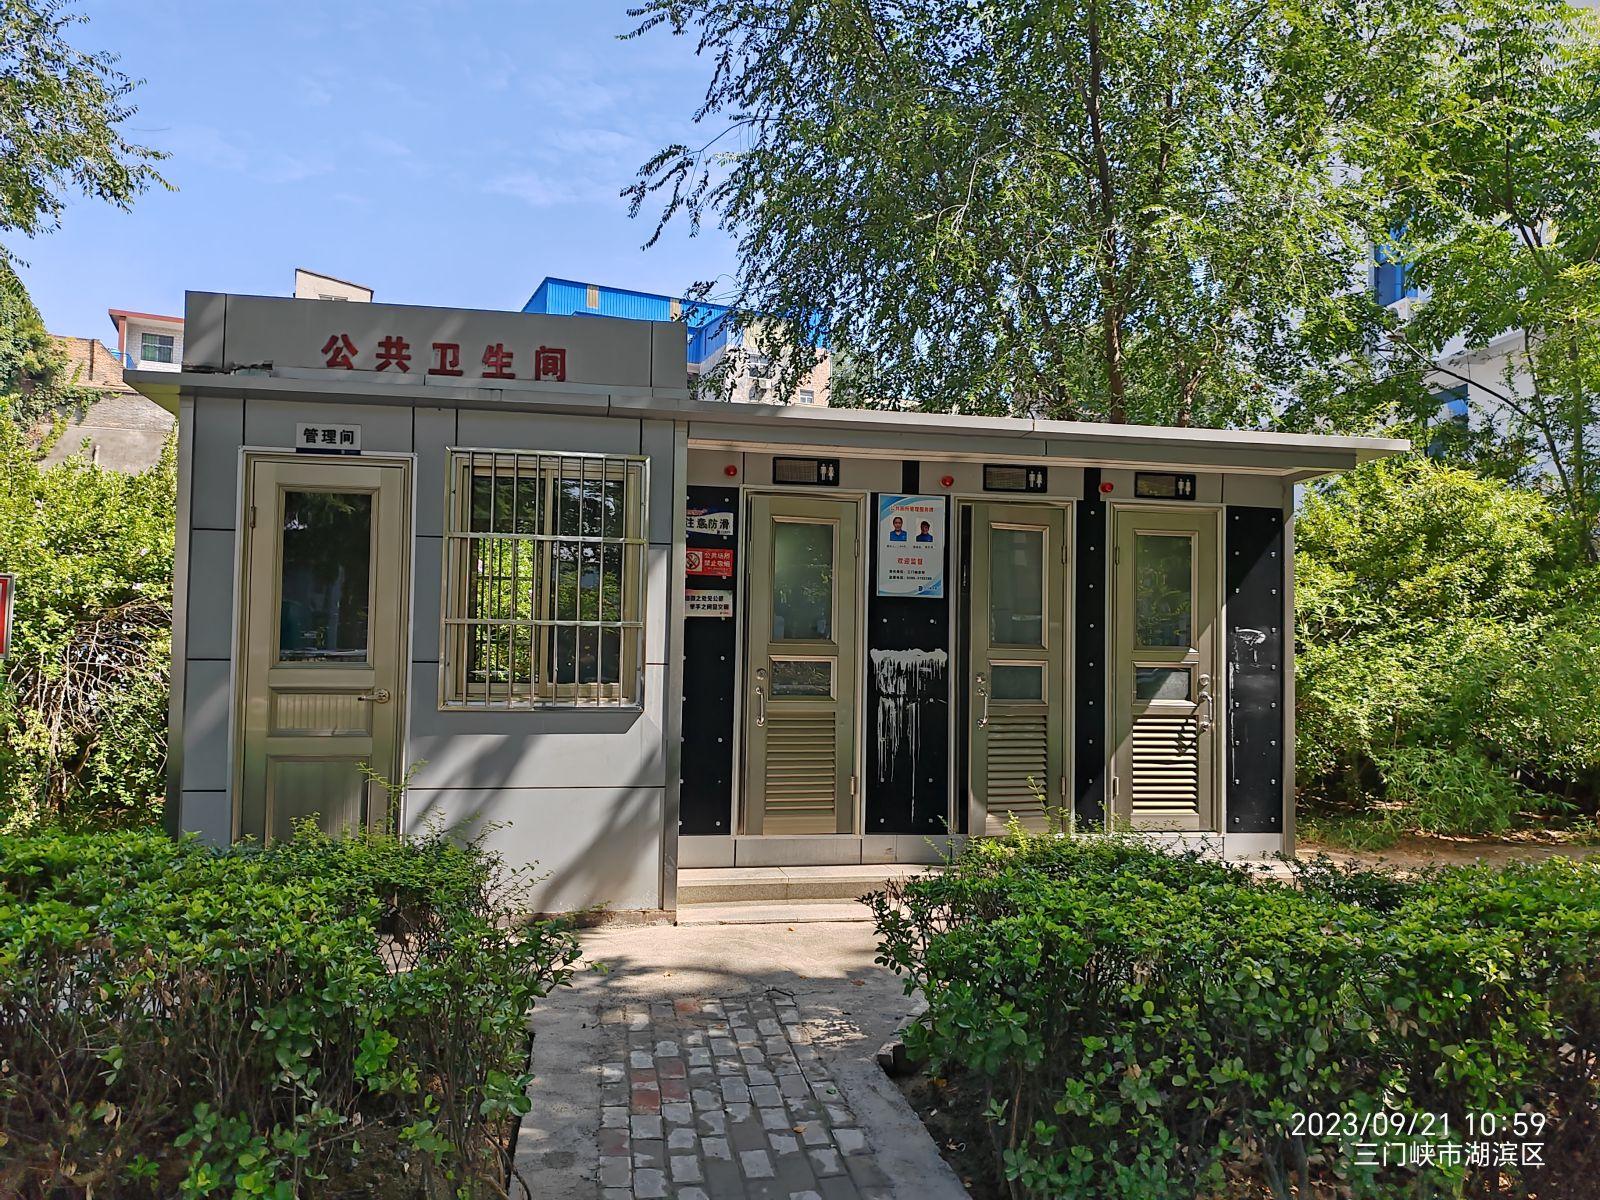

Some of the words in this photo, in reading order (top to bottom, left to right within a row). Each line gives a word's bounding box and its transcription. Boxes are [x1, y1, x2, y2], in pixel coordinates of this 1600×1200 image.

[321, 334, 567, 382] 公共卫生间
[303, 427, 355, 445] 管理间
[686, 517, 730, 530] 注意防滑
[704, 552, 731, 560] 公共场所
[897, 557, 923, 566] 欢迎监督
[704, 560, 731, 568] 禁止吸烟
